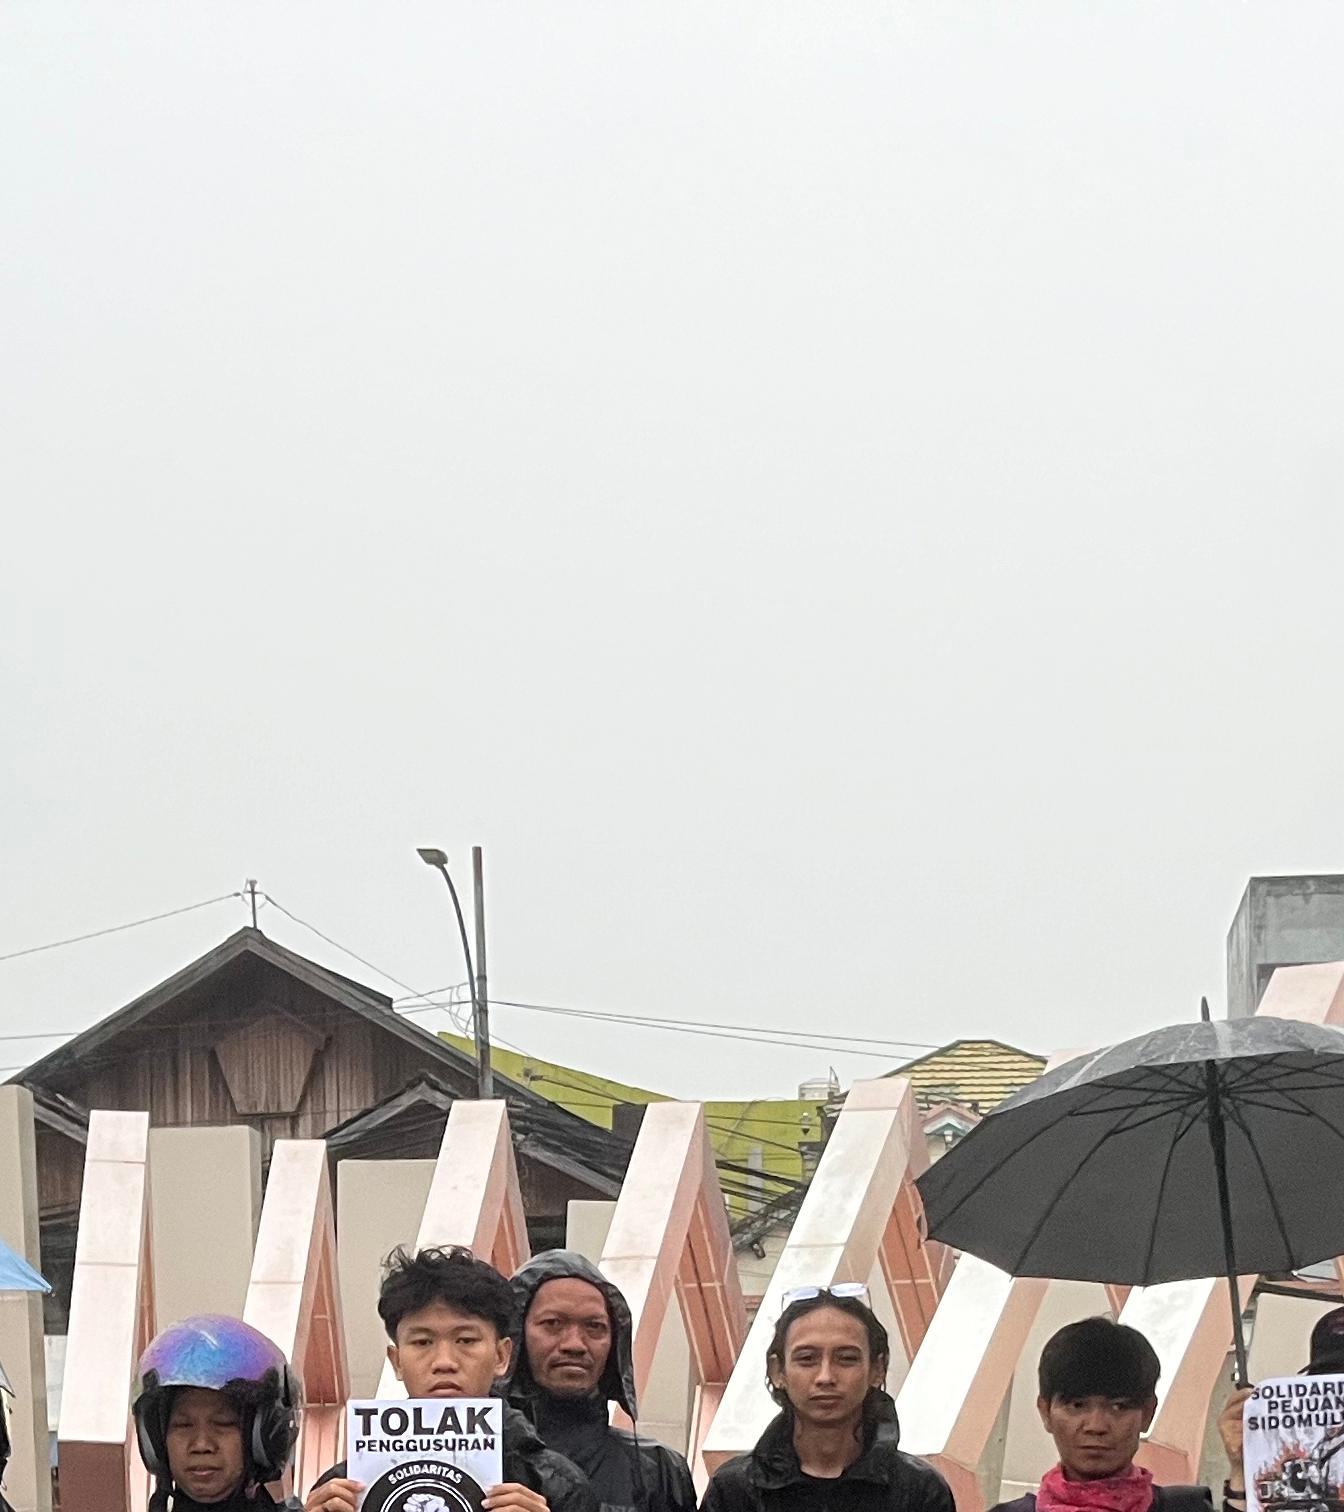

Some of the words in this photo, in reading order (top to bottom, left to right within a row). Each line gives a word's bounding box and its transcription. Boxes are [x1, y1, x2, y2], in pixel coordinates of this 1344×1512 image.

[354, 1406, 496, 1437] TOLAK
[355, 1437, 496, 1453] PENGGUSURAN
[387, 1464, 463, 1485] SOLIDARITAS
